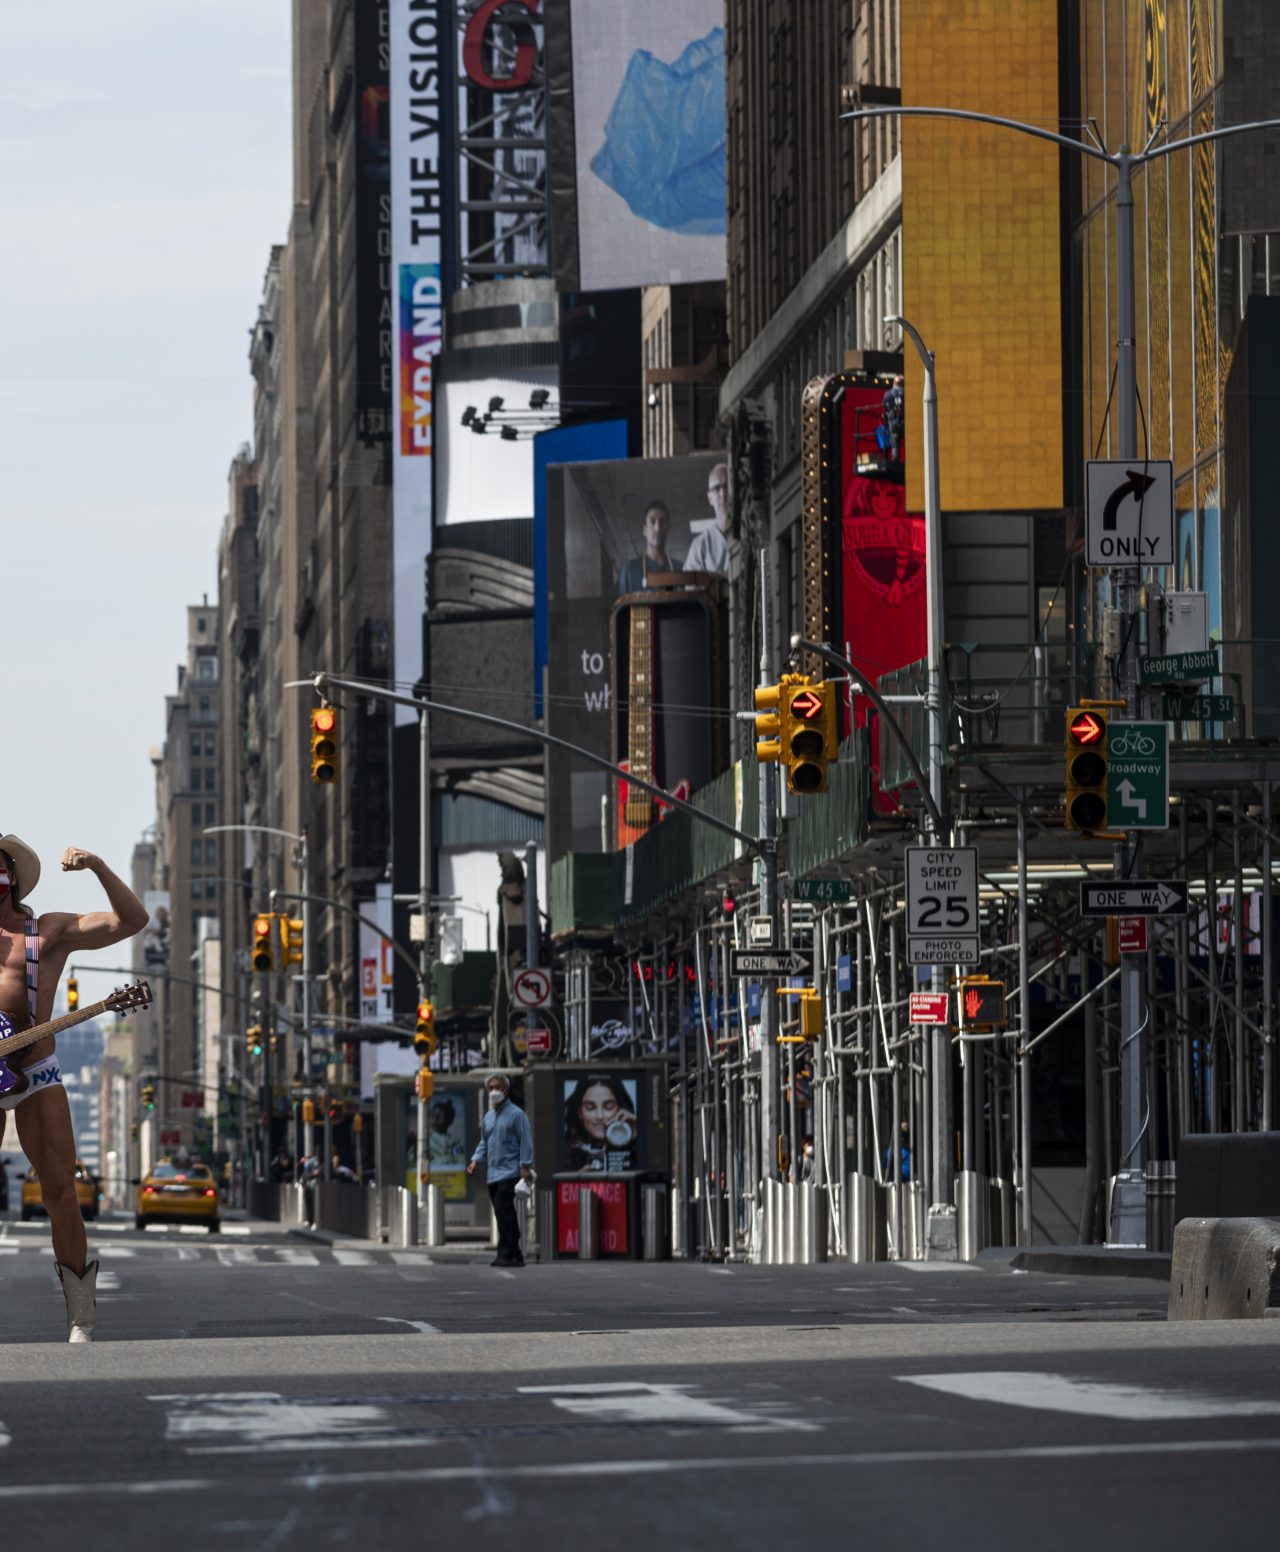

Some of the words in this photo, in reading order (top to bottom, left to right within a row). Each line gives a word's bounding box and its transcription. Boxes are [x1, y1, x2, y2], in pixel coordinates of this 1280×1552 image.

[410, 158, 440, 244] THE
[1101, 537, 1160, 556] ONLY
[581, 649, 604, 674] to
[1143, 659, 1178, 676] George
[1182, 652, 1215, 669] Abbott
[1167, 698, 1182, 718] W
[1191, 698, 1211, 718] 45
[1220, 699, 1230, 712] St
[1107, 762, 1160, 776] Broadway
[926, 853, 955, 863] CITY
[921, 867, 962, 877] SPEED
[797, 882, 810, 897] W
[817, 882, 832, 898] 45
[925, 880, 957, 891] LIMIT
[1096, 892, 1127, 905] ONE
[1140, 892, 1171, 905] WAY
[917, 896, 969, 928] 25
[925, 941, 961, 950] PHOTO
[742, 958, 767, 969] ONE
[776, 958, 800, 969] WAY
[914, 951, 973, 961] ENFORCED
[32, 1066, 62, 1086] NYC
[561, 1182, 622, 1203] EMACE
